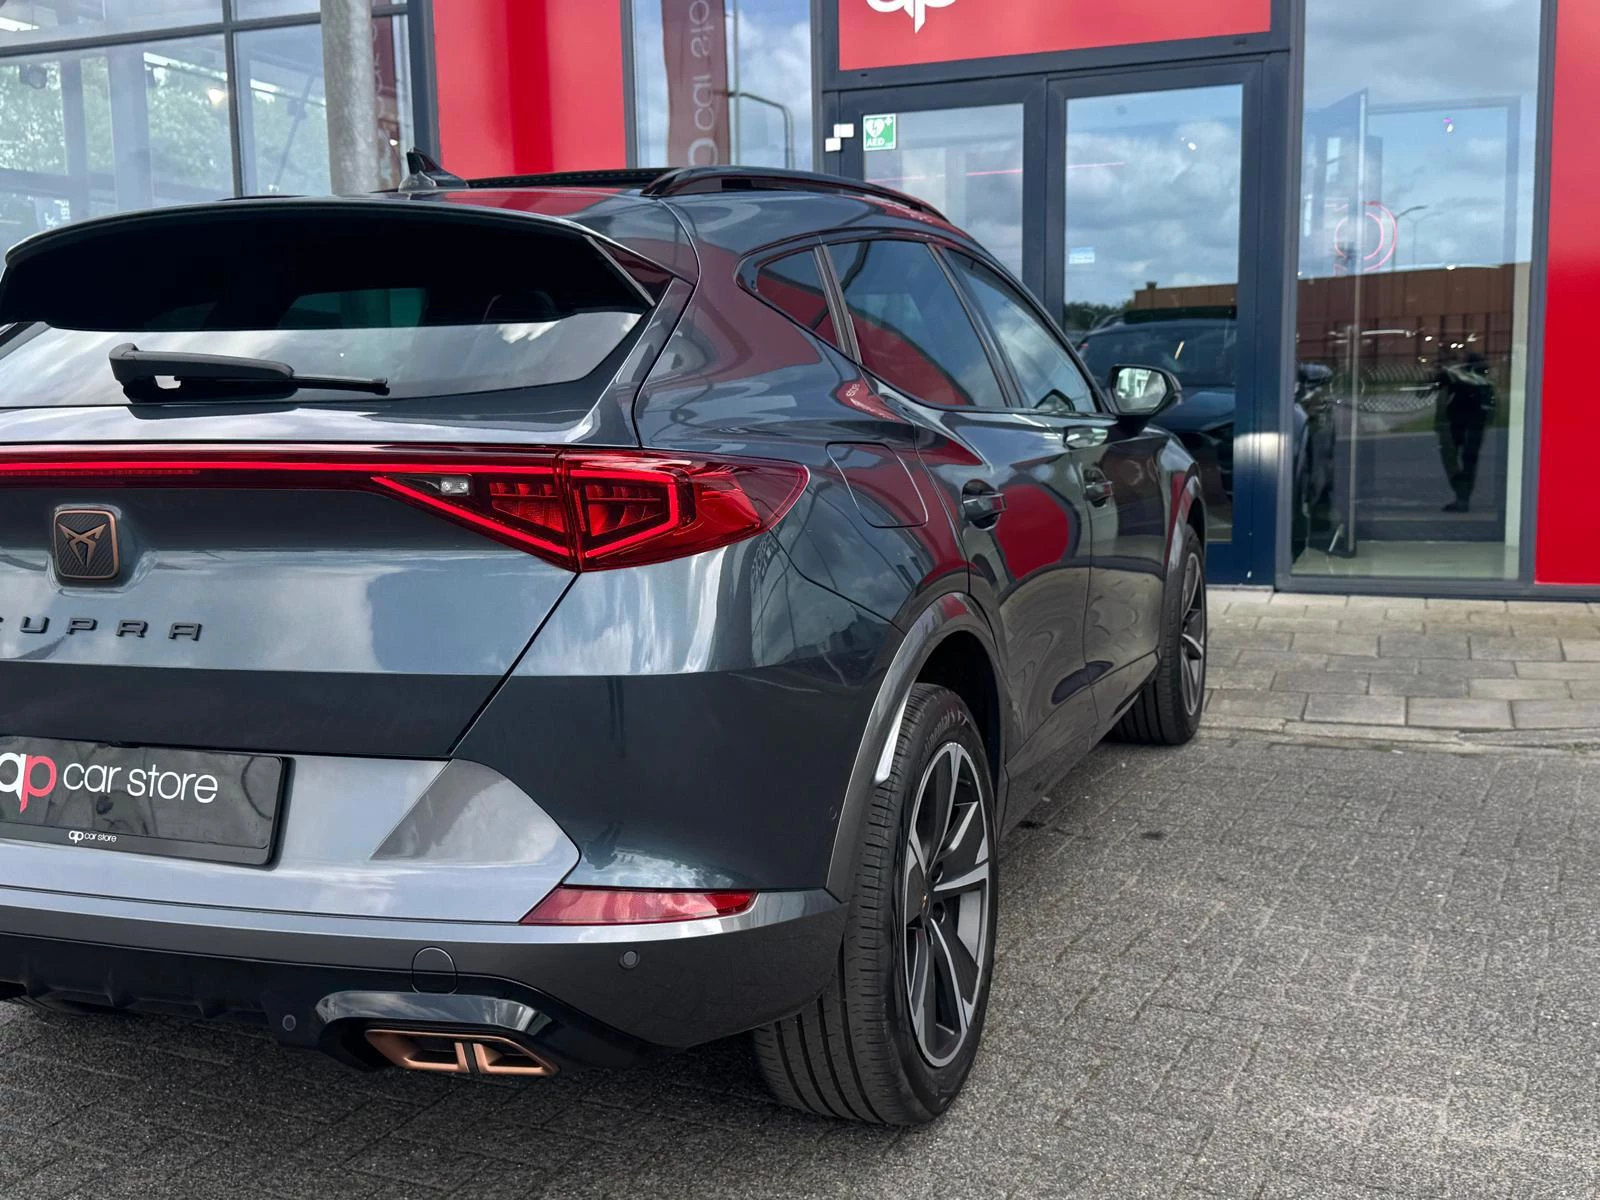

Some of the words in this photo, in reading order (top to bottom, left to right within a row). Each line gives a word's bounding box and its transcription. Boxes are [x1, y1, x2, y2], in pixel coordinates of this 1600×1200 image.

[866, 137, 886, 147] AED
[0, 616, 203, 642] UPRA
[63, 763, 122, 793] car
[127, 764, 219, 804] store
[84, 832, 97, 841] car
[97, 833, 118, 843] store
